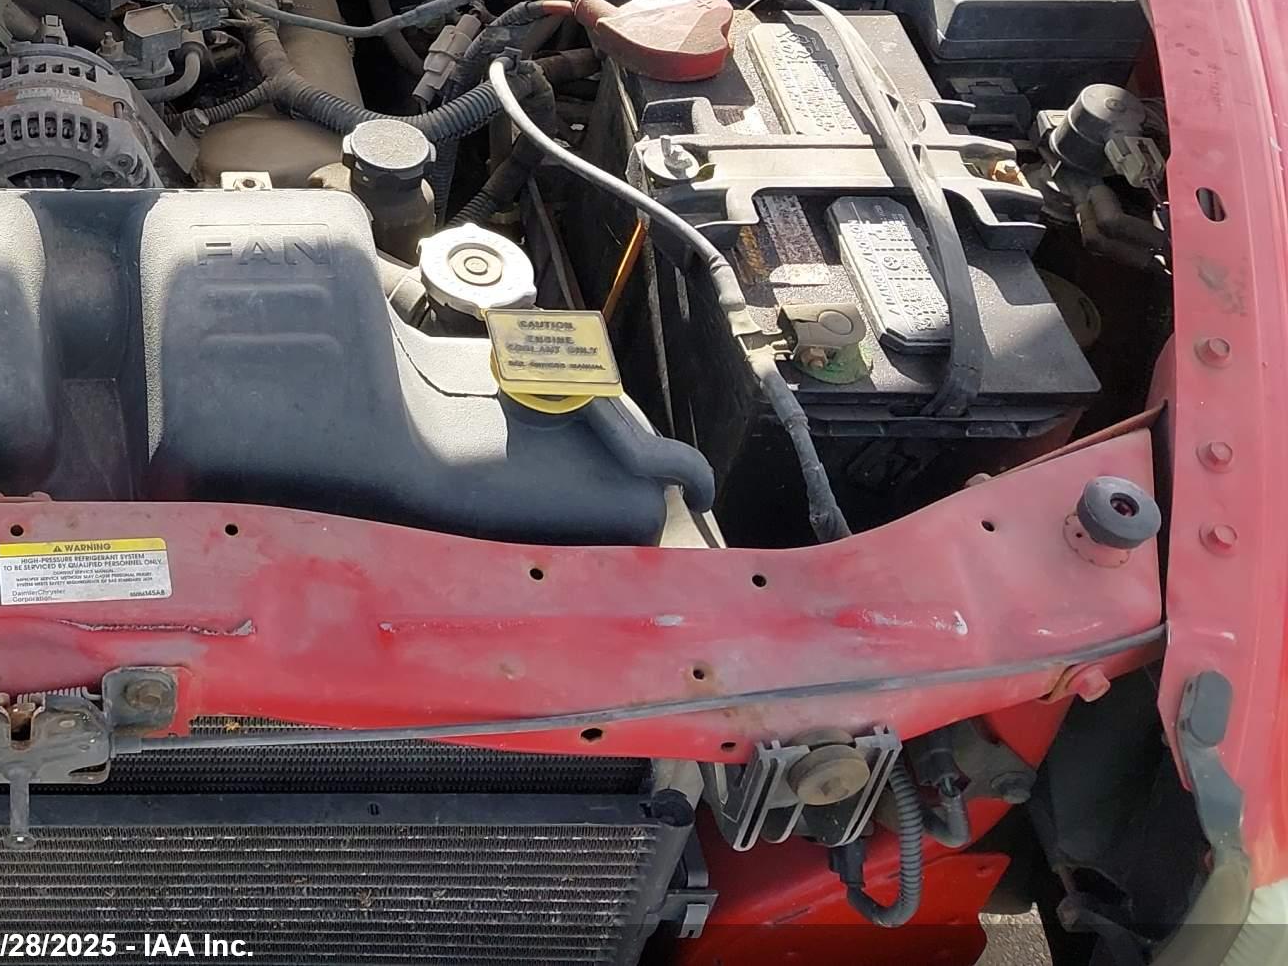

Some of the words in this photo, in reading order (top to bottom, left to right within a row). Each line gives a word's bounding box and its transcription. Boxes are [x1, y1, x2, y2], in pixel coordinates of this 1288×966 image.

[196, 237, 331, 266] FAN
[519, 320, 575, 331] CAUTION
[525, 335, 575, 345] ENGINE
[506, 342, 561, 354] COOLANT
[567, 346, 598, 355] ONLY
[64, 543, 111, 552] WARNING
[74, 553, 119, 562] REFRIGERANT
[68, 560, 103, 568] QUALIFIED
[104, 559, 144, 567] PERSONNEL
[12, 589, 66, 597] DaimlerChrysler
